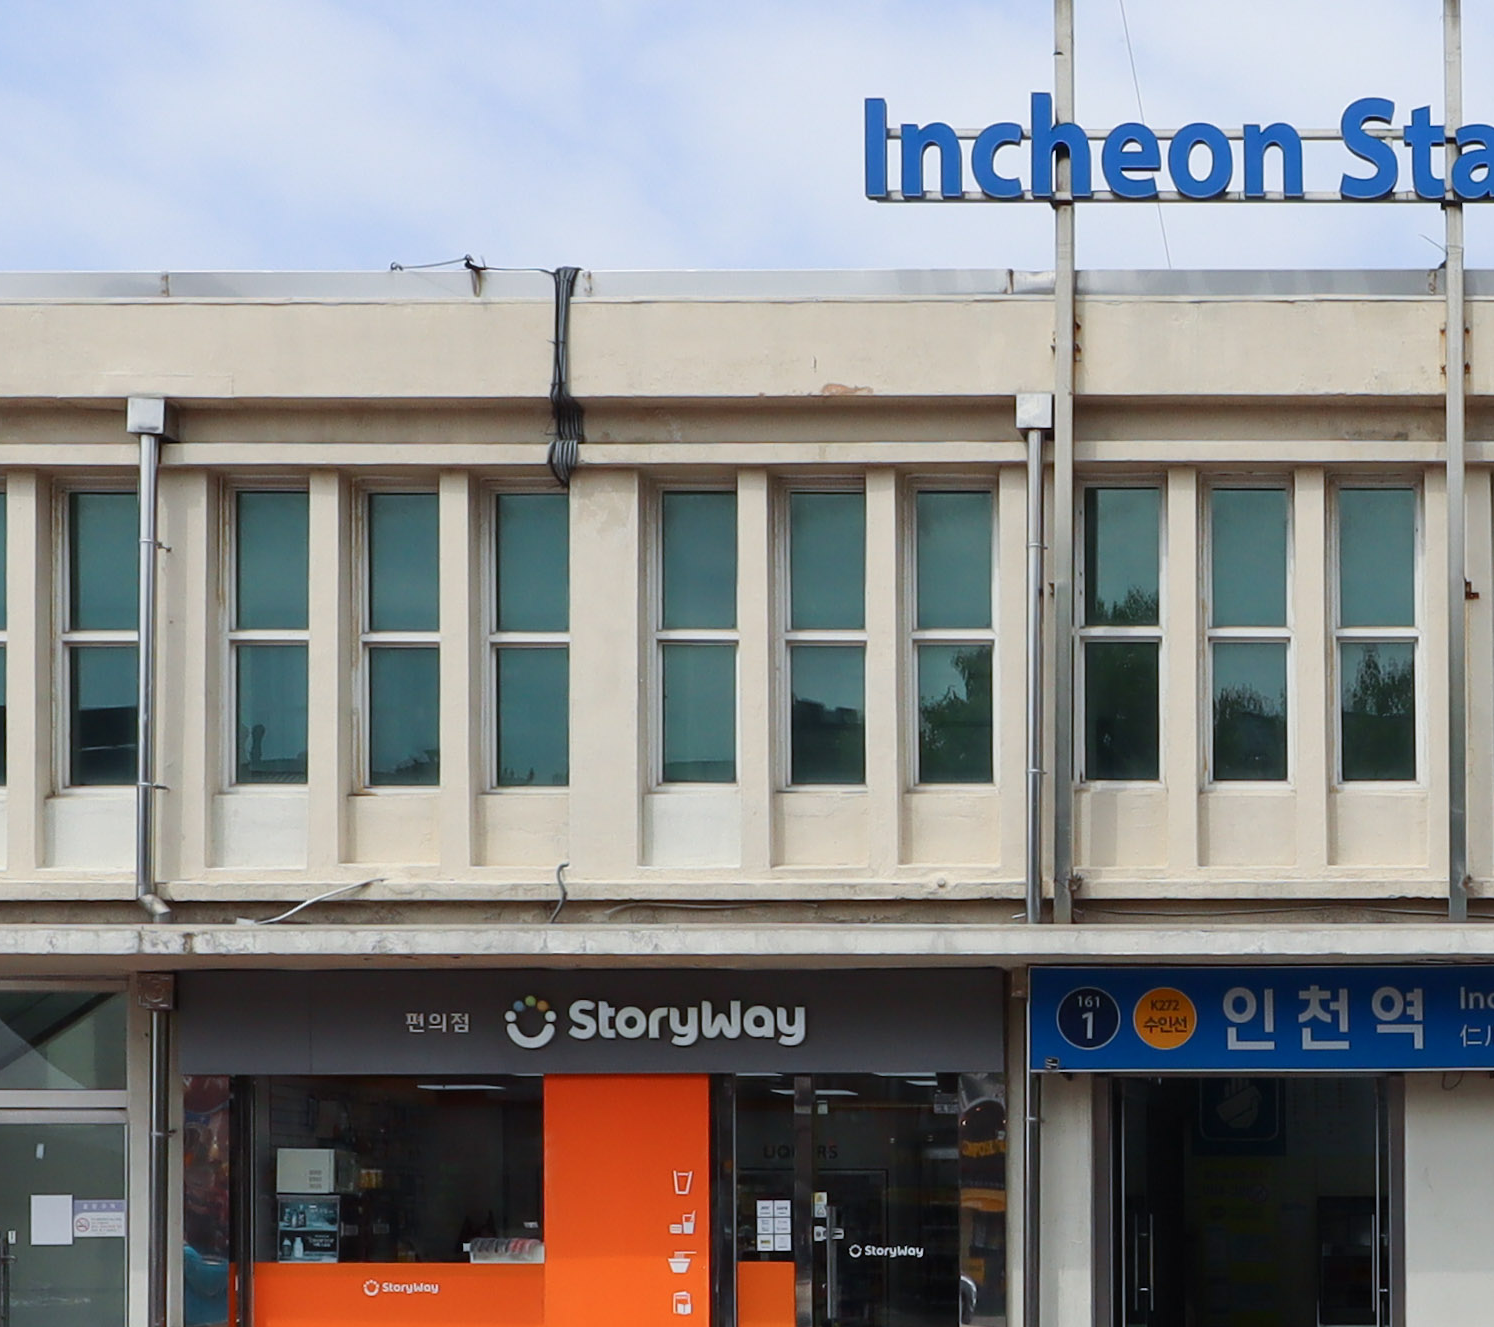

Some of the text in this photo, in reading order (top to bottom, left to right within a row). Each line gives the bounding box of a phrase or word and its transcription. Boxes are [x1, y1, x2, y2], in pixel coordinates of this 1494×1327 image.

[864, 91, 1304, 200] Incheon
[1076, 994, 1101, 1009] 161
[1150, 998, 1180, 1013] K272
[405, 1012, 471, 1034] 편의점
[567, 999, 807, 1047] StoryWay
[1081, 1011, 1094, 1040] 1
[1142, 1015, 1188, 1035] 수인선
[1222, 985, 1425, 1051] 인천역
[864, 1244, 925, 1259] StoryWay
[381, 1281, 440, 1295] StoryWay
